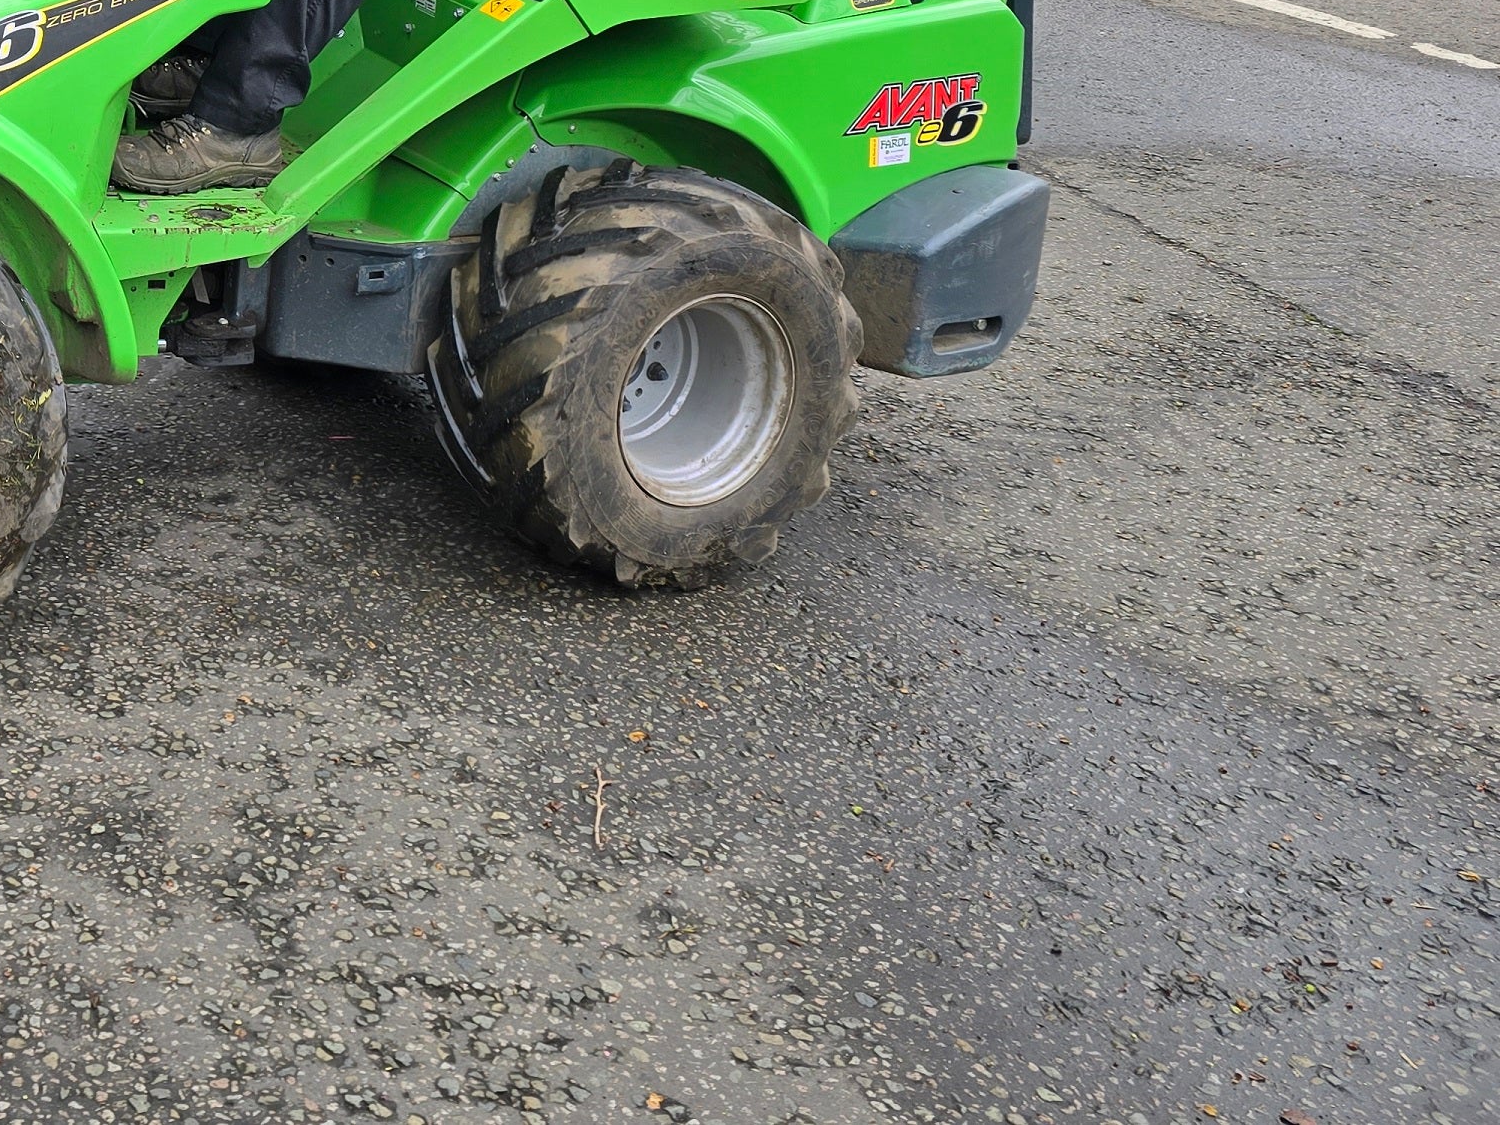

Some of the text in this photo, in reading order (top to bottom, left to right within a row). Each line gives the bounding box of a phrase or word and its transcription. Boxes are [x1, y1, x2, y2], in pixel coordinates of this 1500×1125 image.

[46, 2, 103, 29] ZERO
[844, 73, 981, 136] AVANT
[916, 99, 988, 146] e6
